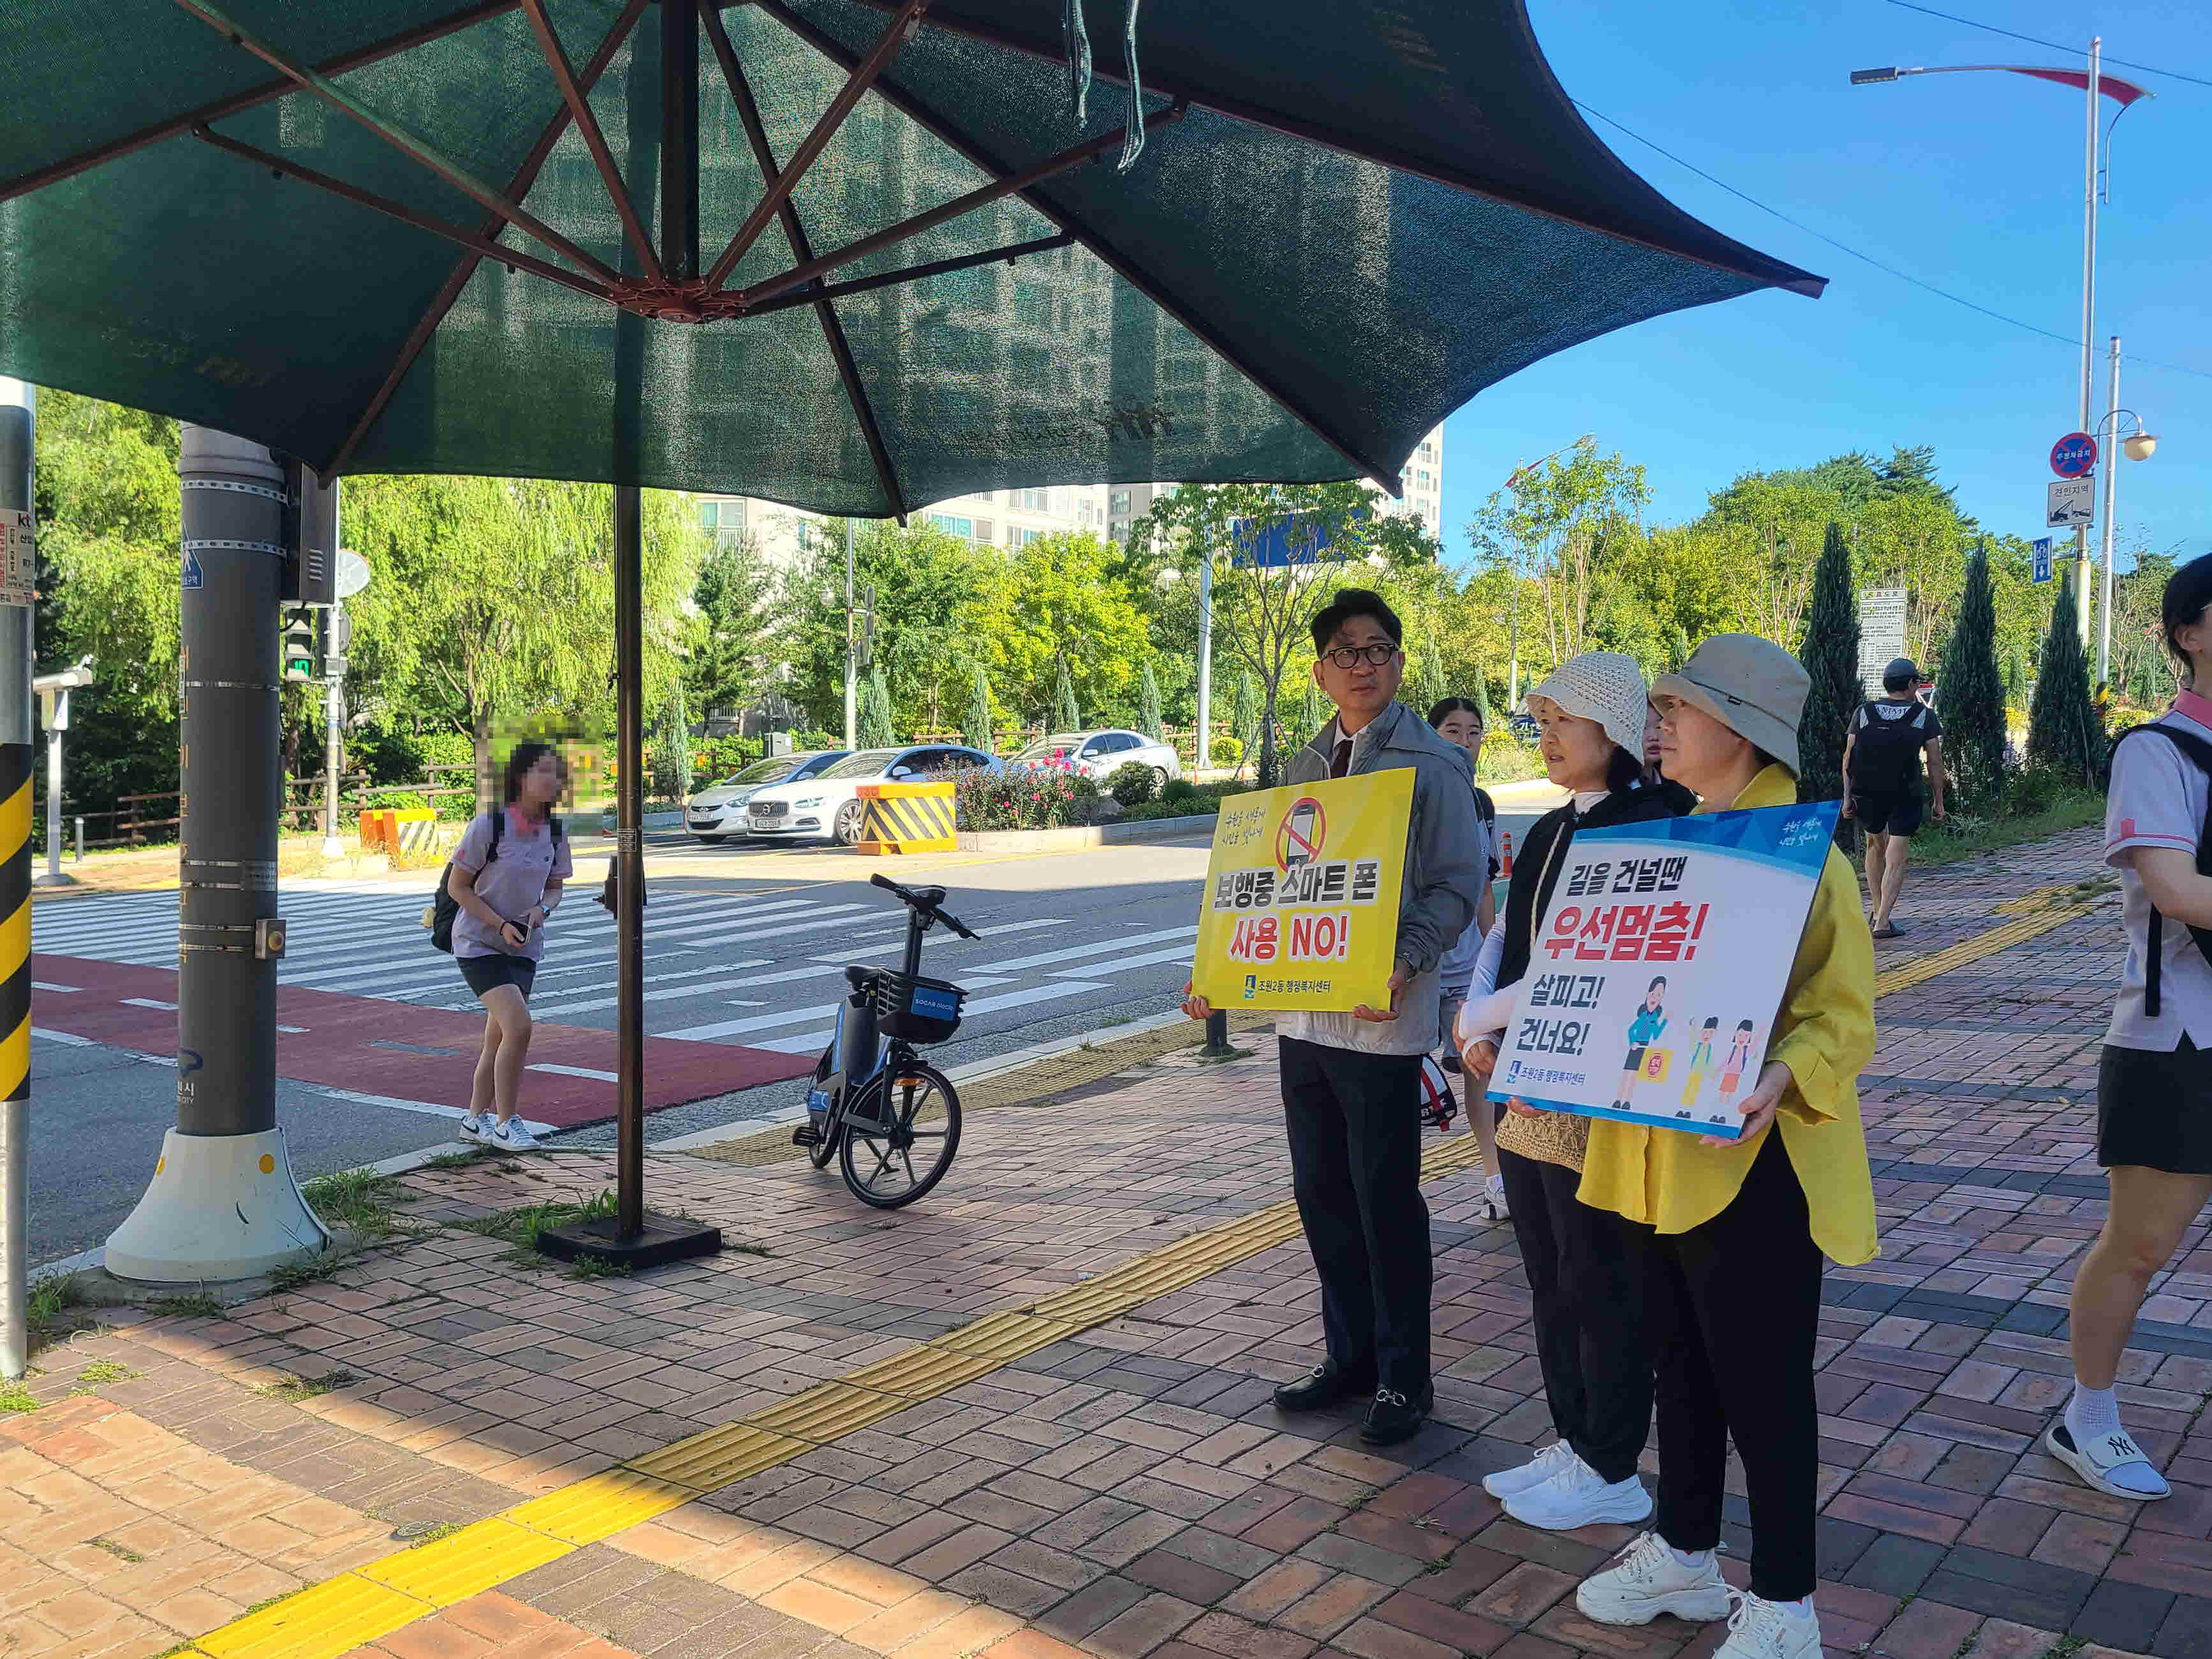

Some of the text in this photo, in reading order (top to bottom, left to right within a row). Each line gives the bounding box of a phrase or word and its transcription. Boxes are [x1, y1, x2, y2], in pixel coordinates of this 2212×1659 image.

[1567, 855, 1689, 897] 길을 건널땐
[1230, 916, 1348, 959] 사용 NO!
[1544, 900, 1711, 961] 우선멈춤!
[1259, 979, 1331, 994] 조원2동 행정복지센터
[1530, 974, 1605, 1009] 살피고!
[1516, 1018, 1591, 1056] 건너요!
[1521, 1066, 1586, 1086] 조원2동 행정복지센터
